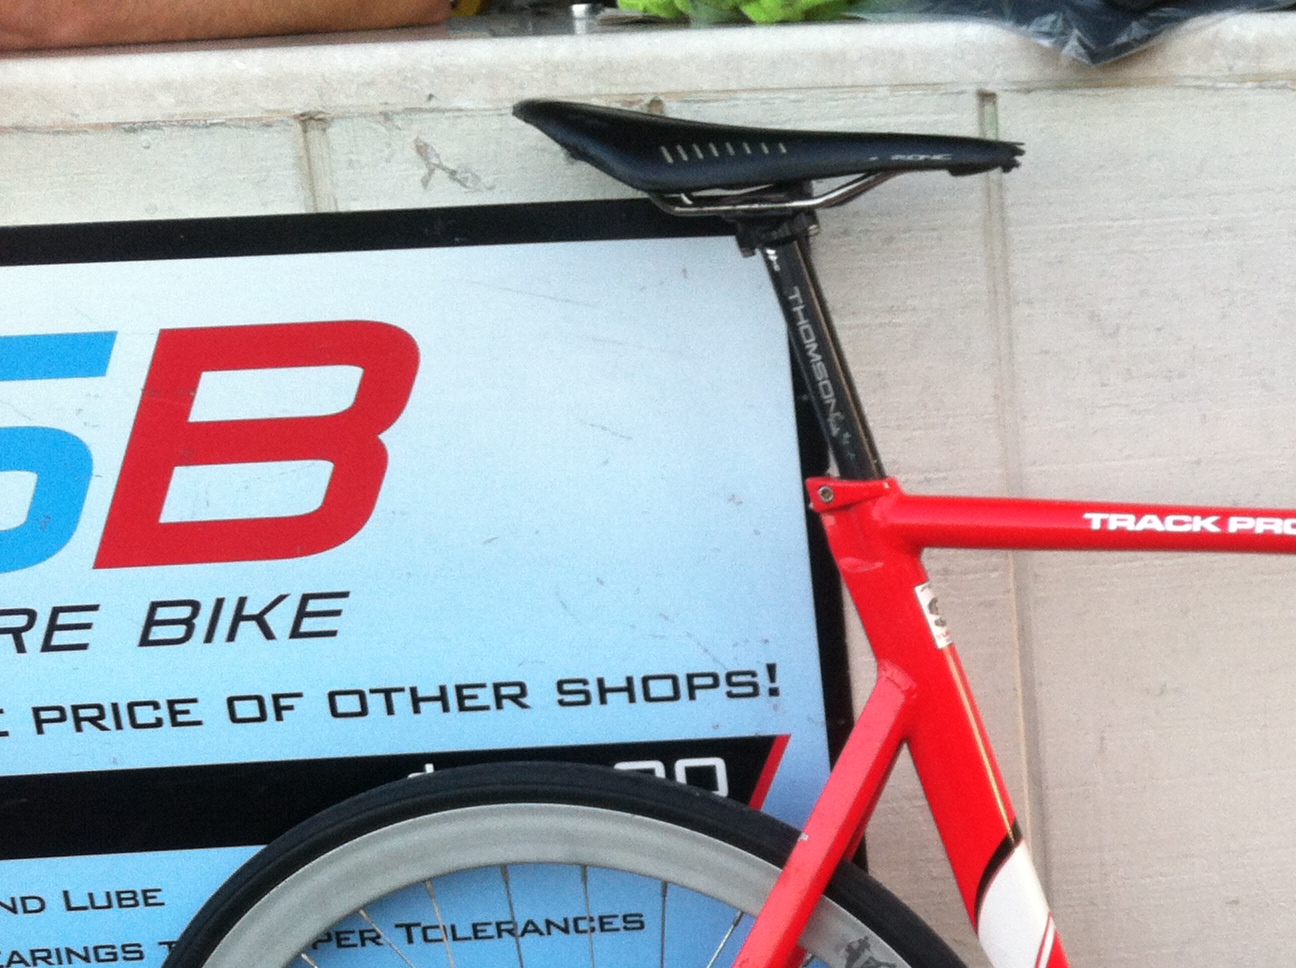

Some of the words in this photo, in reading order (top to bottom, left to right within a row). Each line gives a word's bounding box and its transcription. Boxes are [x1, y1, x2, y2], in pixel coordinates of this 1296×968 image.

[788, 285, 841, 424] THOMSON
[1083, 512, 1221, 533] TRACK
[138, 591, 350, 648] BIKE
[31, 697, 203, 735] PRICE
[226, 692, 304, 724] OF
[327, 680, 533, 719] OTHER
[555, 662, 781, 708] SHOPS!
[62, 888, 165, 912] LUBE
[0, 942, 145, 968] ARINGS
[395, 912, 645, 946] TOLERANCES
